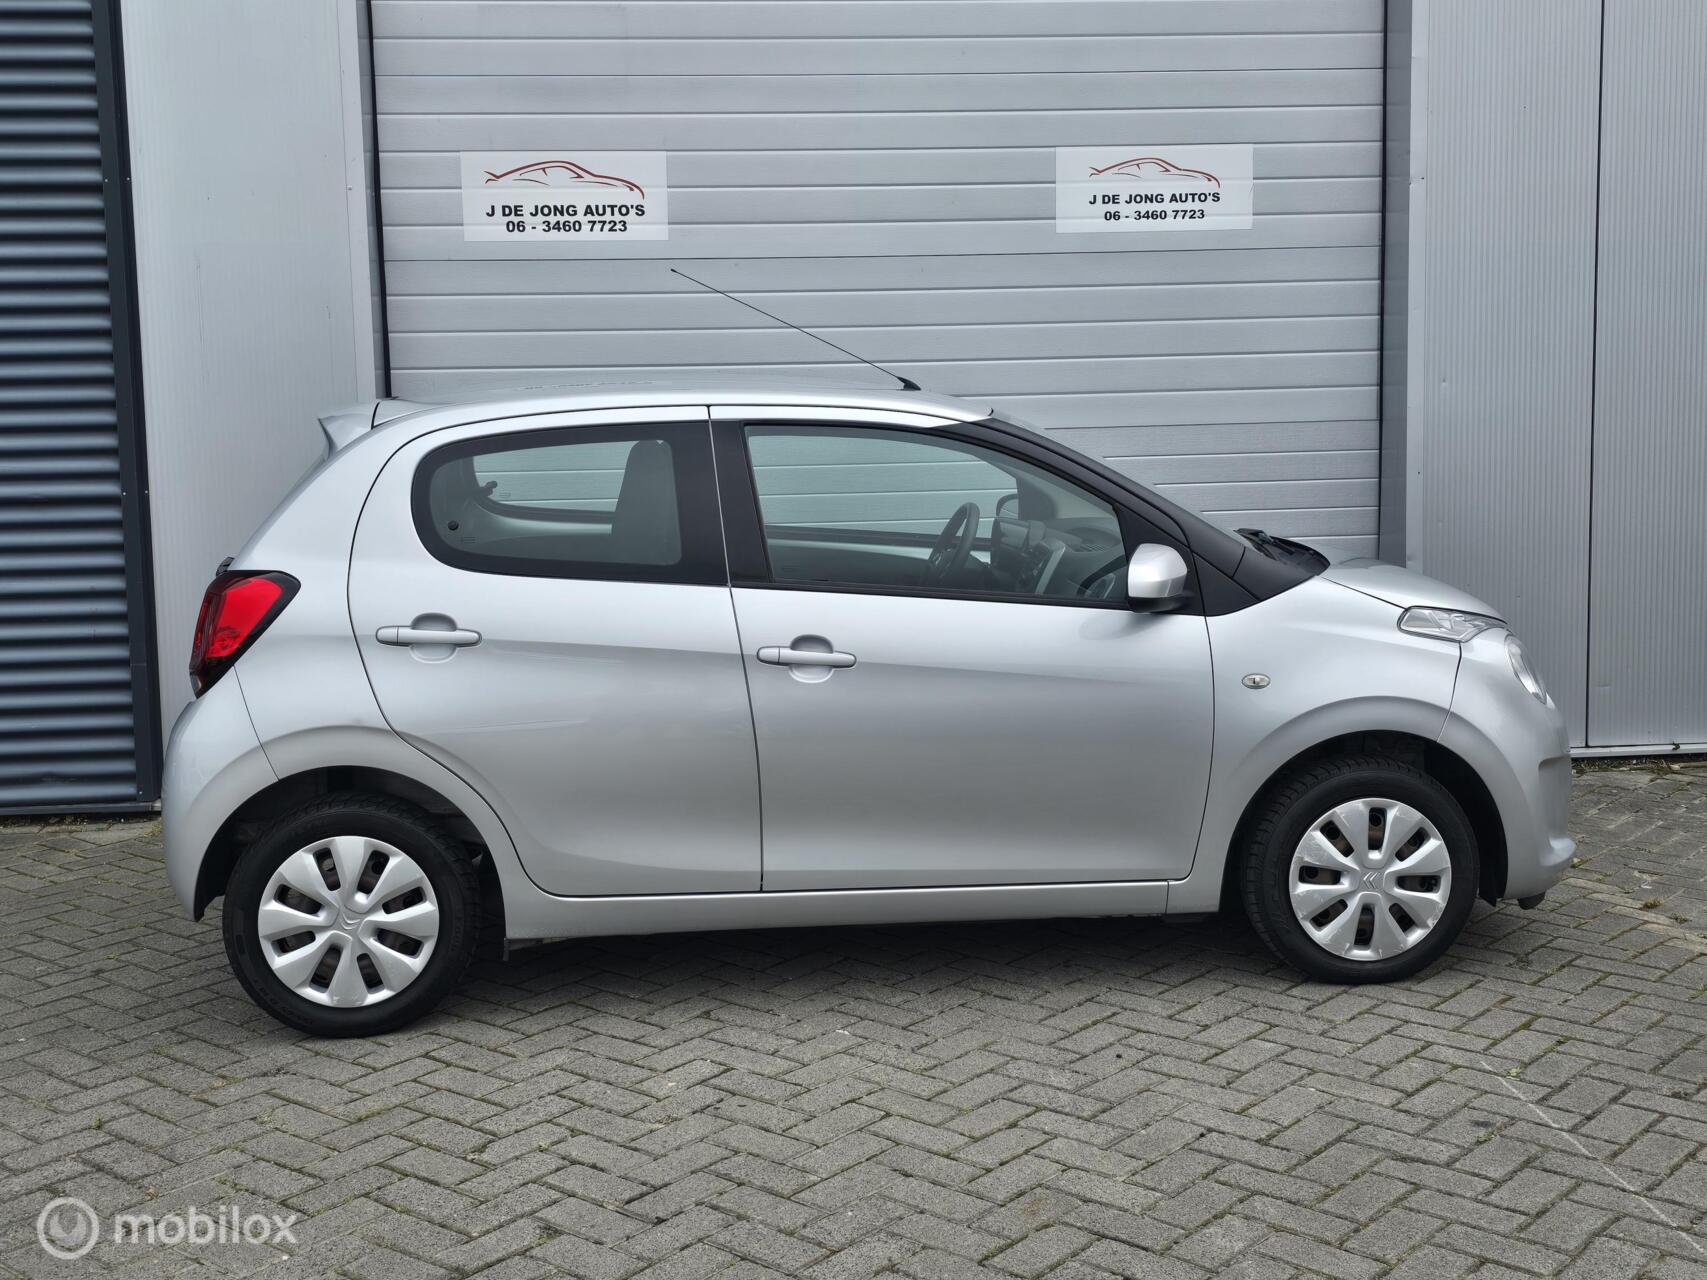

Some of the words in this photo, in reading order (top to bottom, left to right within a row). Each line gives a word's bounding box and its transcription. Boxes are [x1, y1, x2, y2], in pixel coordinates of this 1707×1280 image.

[1088, 194, 1097, 205] J
[1101, 194, 1121, 205] DE
[1124, 193, 1165, 205] JONG
[1168, 192, 1221, 204] AUTO'S
[486, 205, 496, 217] J
[501, 205, 524, 217] DE
[529, 204, 578, 217] JONG
[583, 204, 646, 217] AUTO'S
[1104, 210, 1121, 221] 06
[1133, 210, 1168, 221] 3460
[1171, 209, 1206, 220] 7723
[505, 220, 526, 233] 06
[542, 219, 582, 233] 3460
[587, 219, 628, 232] 7723
